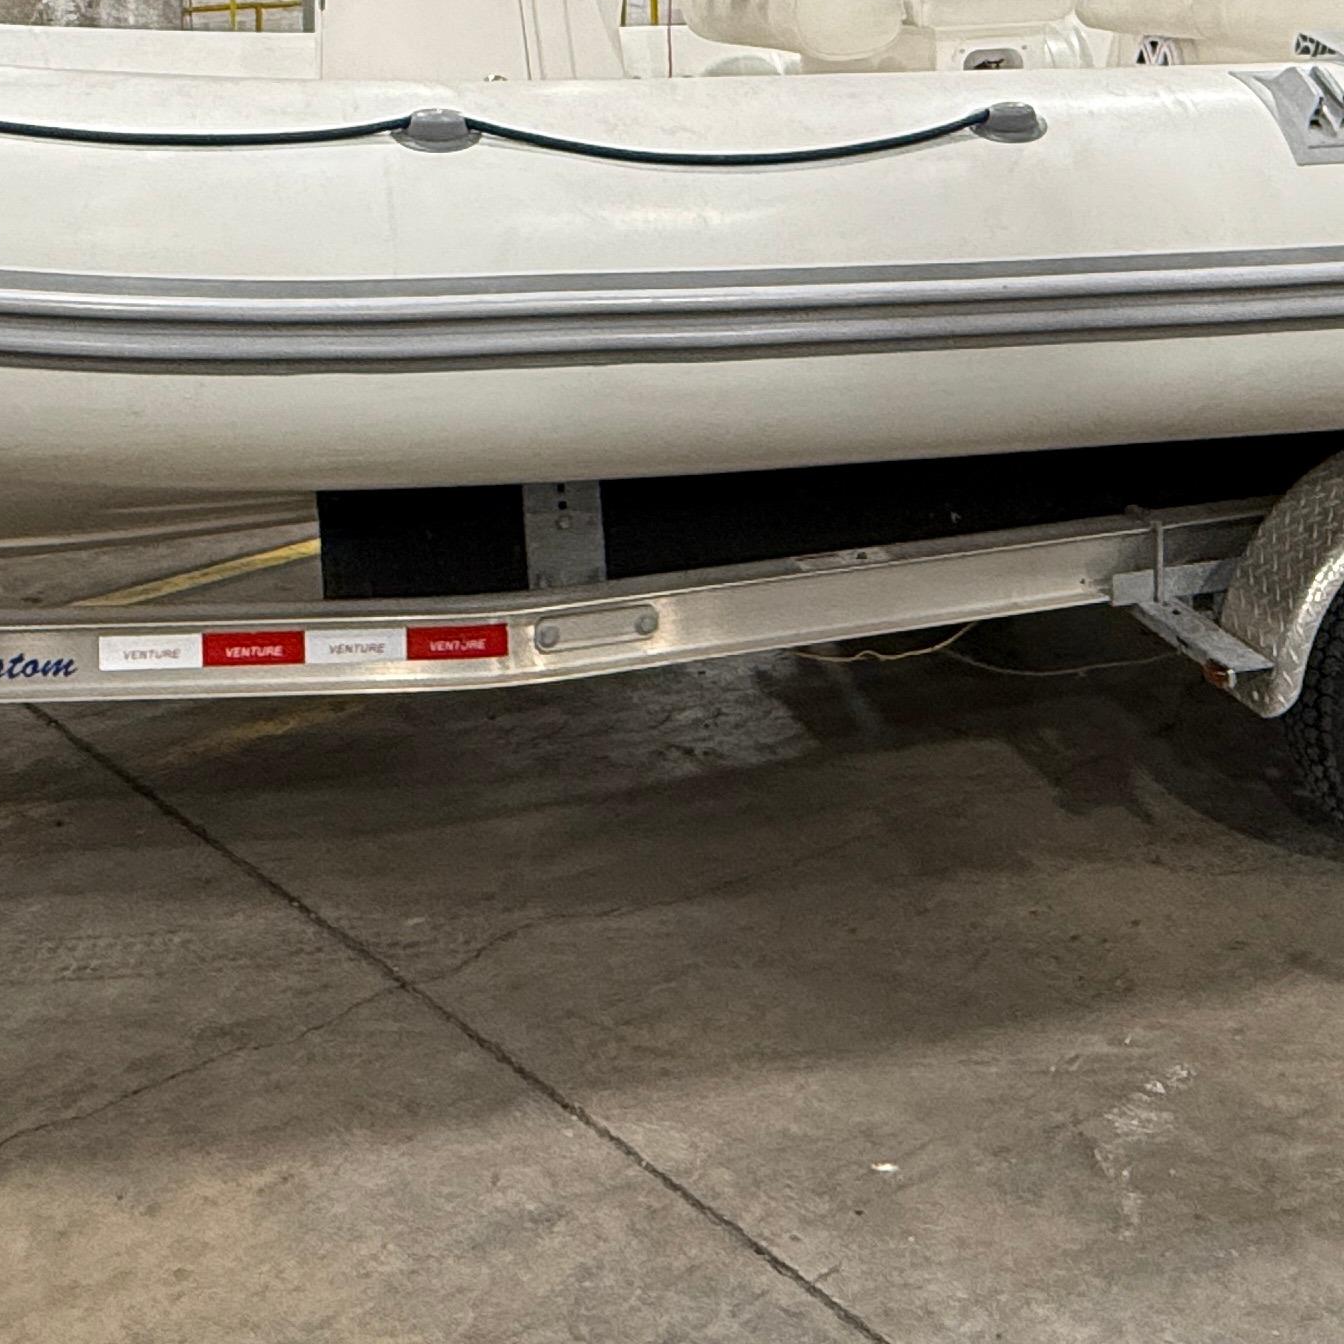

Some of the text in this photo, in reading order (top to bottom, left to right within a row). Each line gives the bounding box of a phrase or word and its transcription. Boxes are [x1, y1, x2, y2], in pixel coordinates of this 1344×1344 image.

[225, 644, 283, 659] VENTURE
[329, 641, 385, 655] VENTURE
[429, 638, 487, 653] VENTURE
[123, 647, 182, 661] VENTURE
